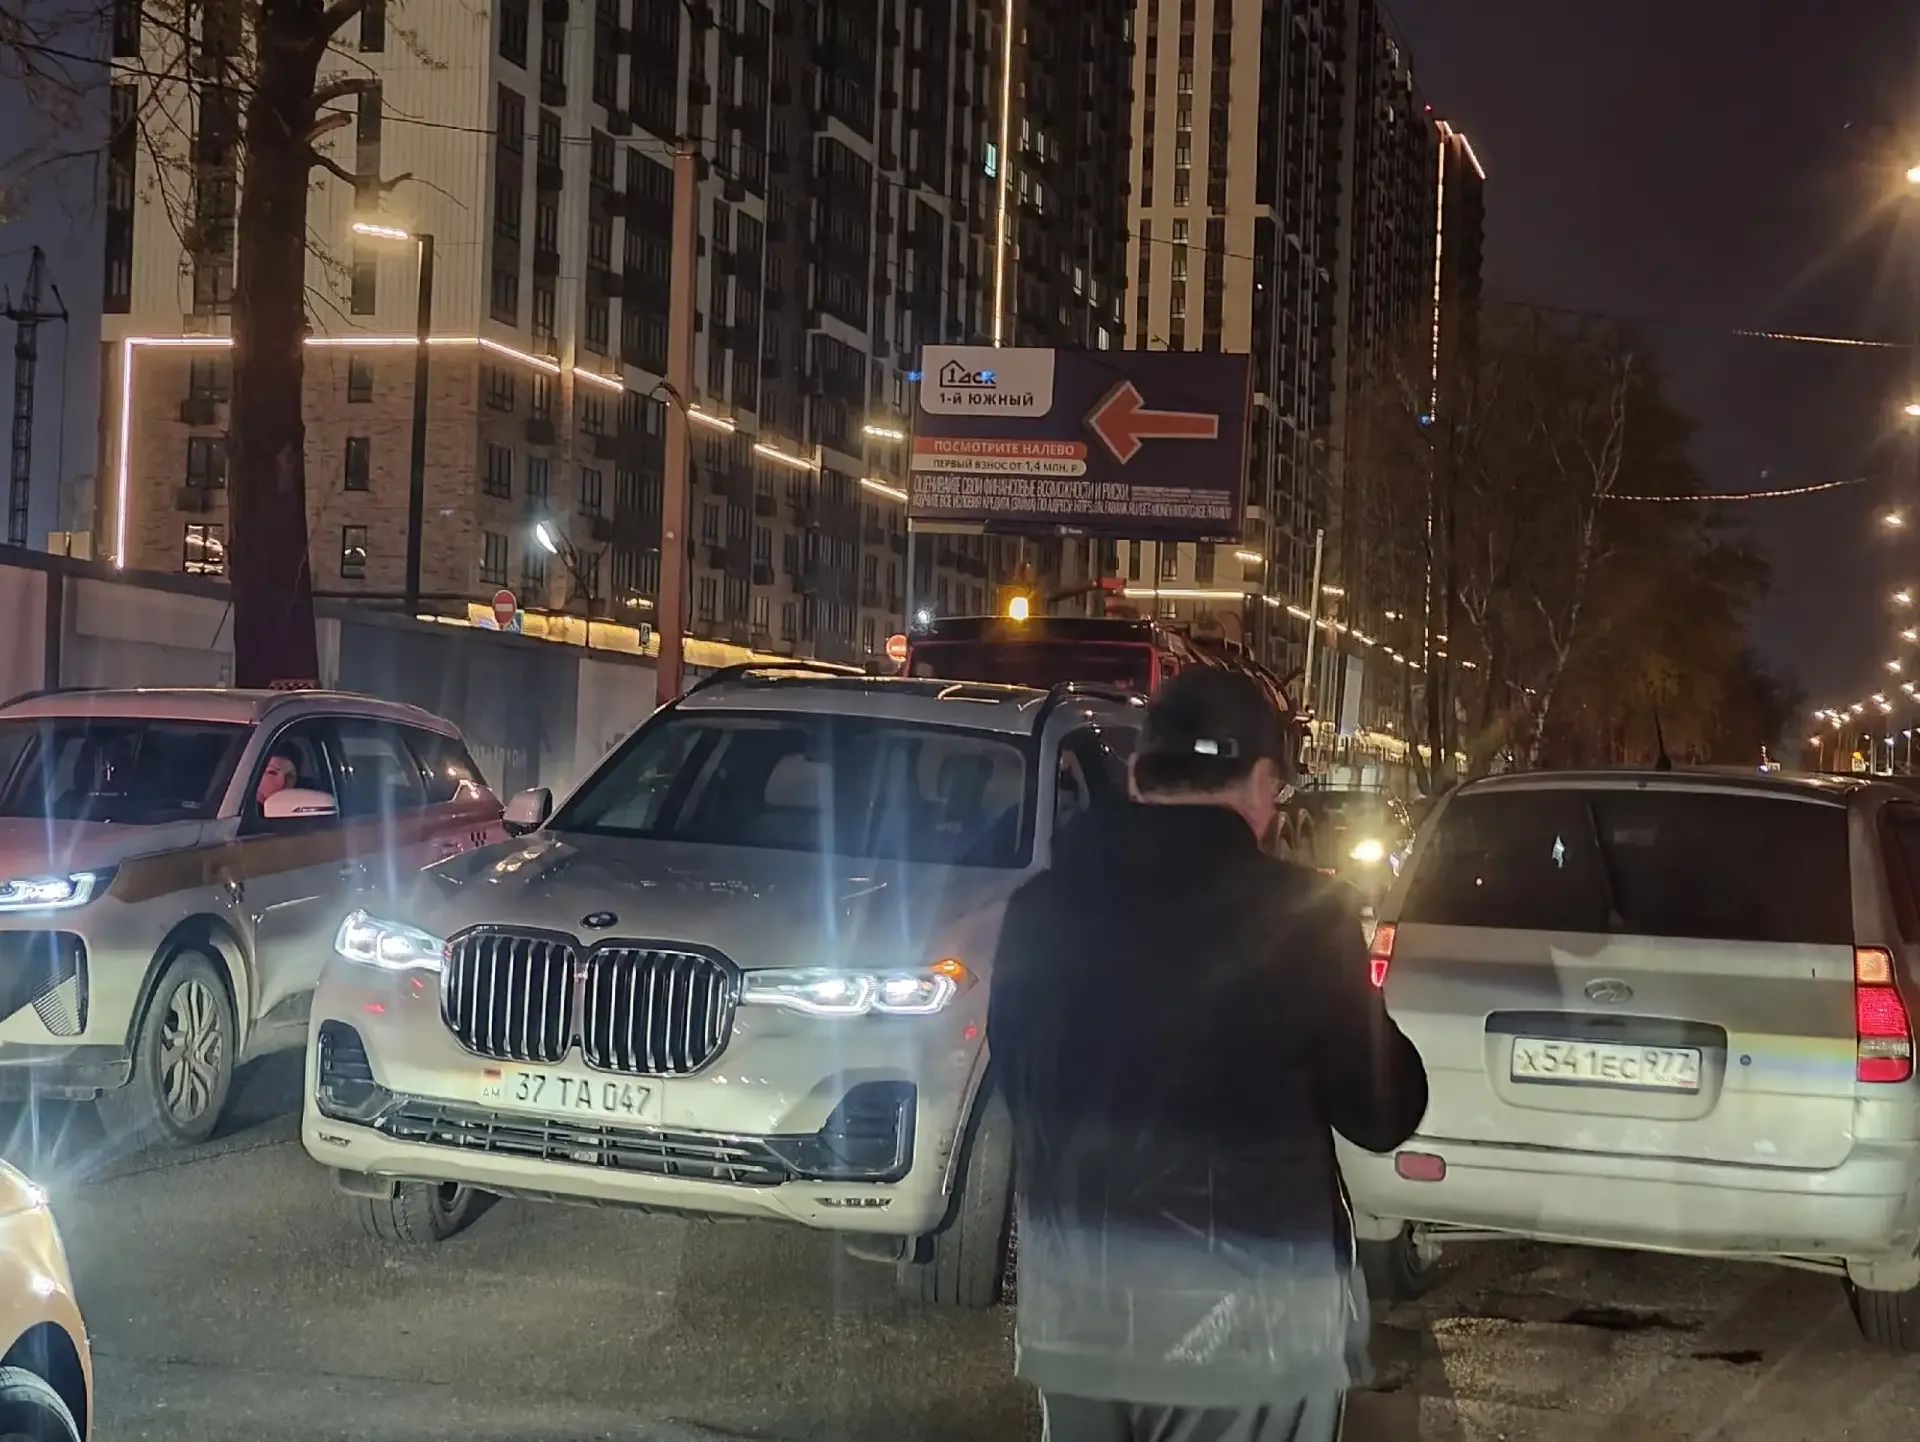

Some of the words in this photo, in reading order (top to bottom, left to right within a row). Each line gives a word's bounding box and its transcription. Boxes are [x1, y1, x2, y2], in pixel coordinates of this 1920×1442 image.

[968, 392, 1034, 407] ЮЖНЫЙ
[934, 440, 1019, 454] ПОСМОТРИТЕ
[1023, 445, 1075, 456] НАЛЕВО
[933, 459, 973, 469] ПЕРВЫЙ
[975, 461, 1007, 471] ВЗНОС
[1009, 463, 1022, 471] ОТ
[1025, 461, 1041, 473] 1,4
[516, 1072, 546, 1103] 37
[557, 1076, 593, 1110] TA
[602, 1081, 652, 1117] 047
